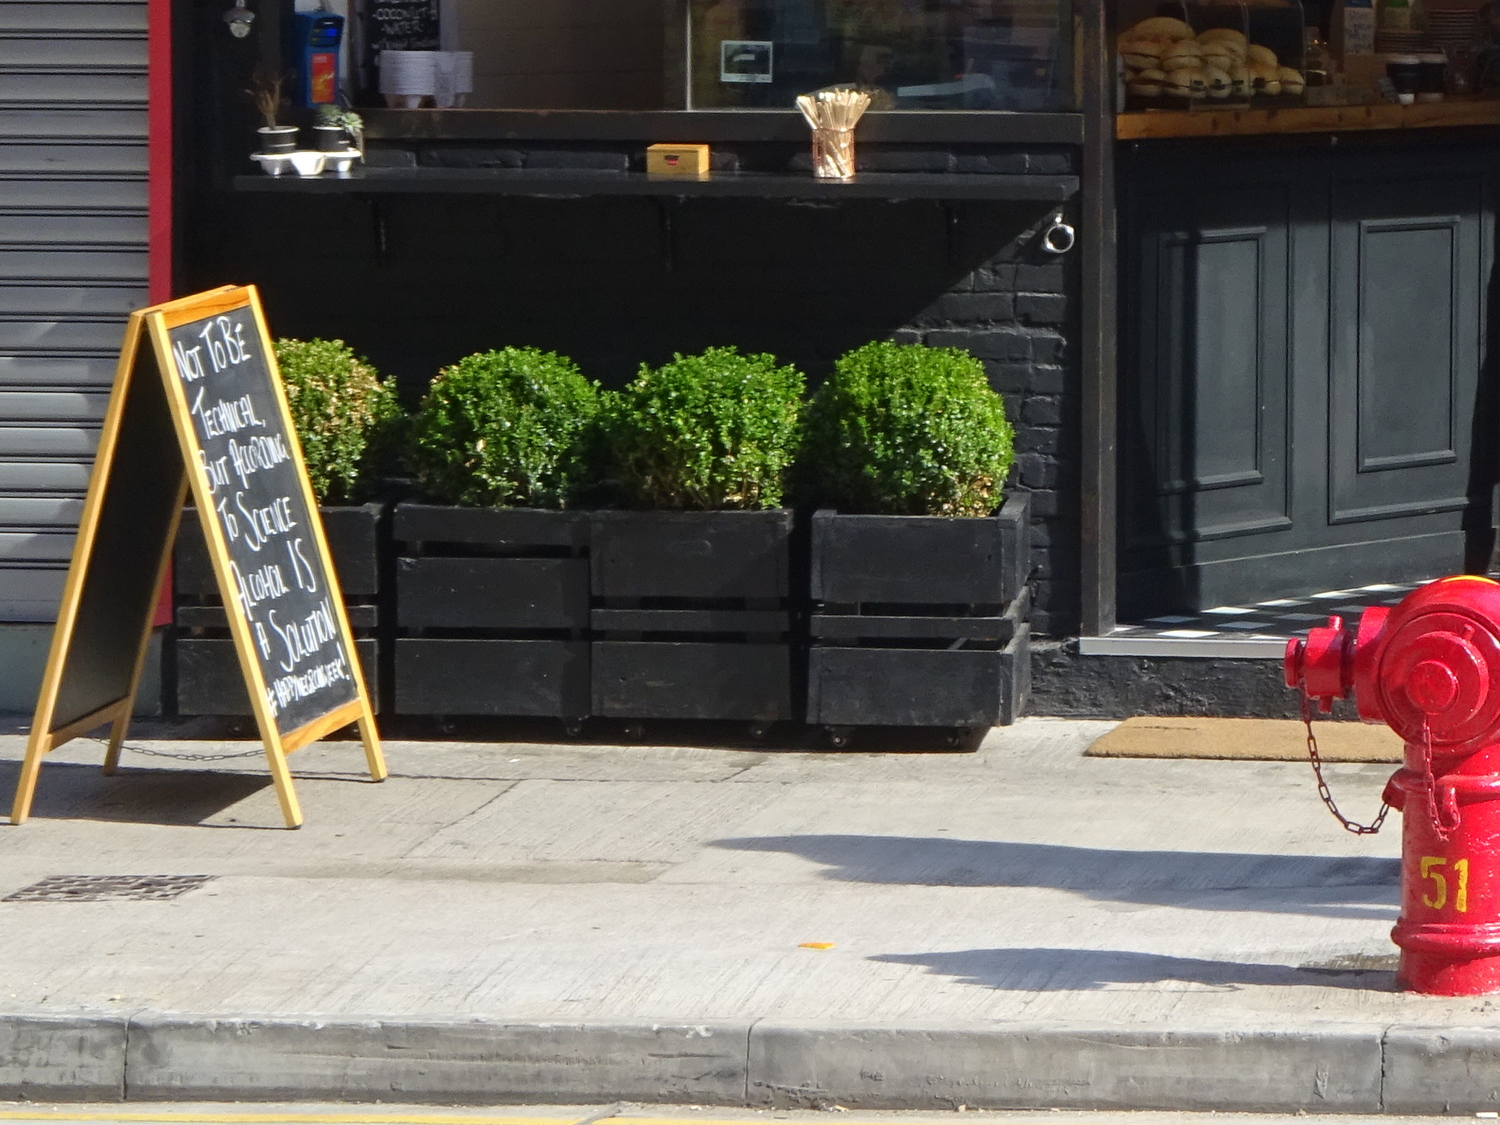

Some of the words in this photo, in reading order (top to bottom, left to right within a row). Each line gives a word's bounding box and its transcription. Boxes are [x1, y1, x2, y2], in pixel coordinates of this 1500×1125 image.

[286, 538, 317, 593] IS
[254, 621, 271, 661] A
[1421, 856, 1469, 913] 51
